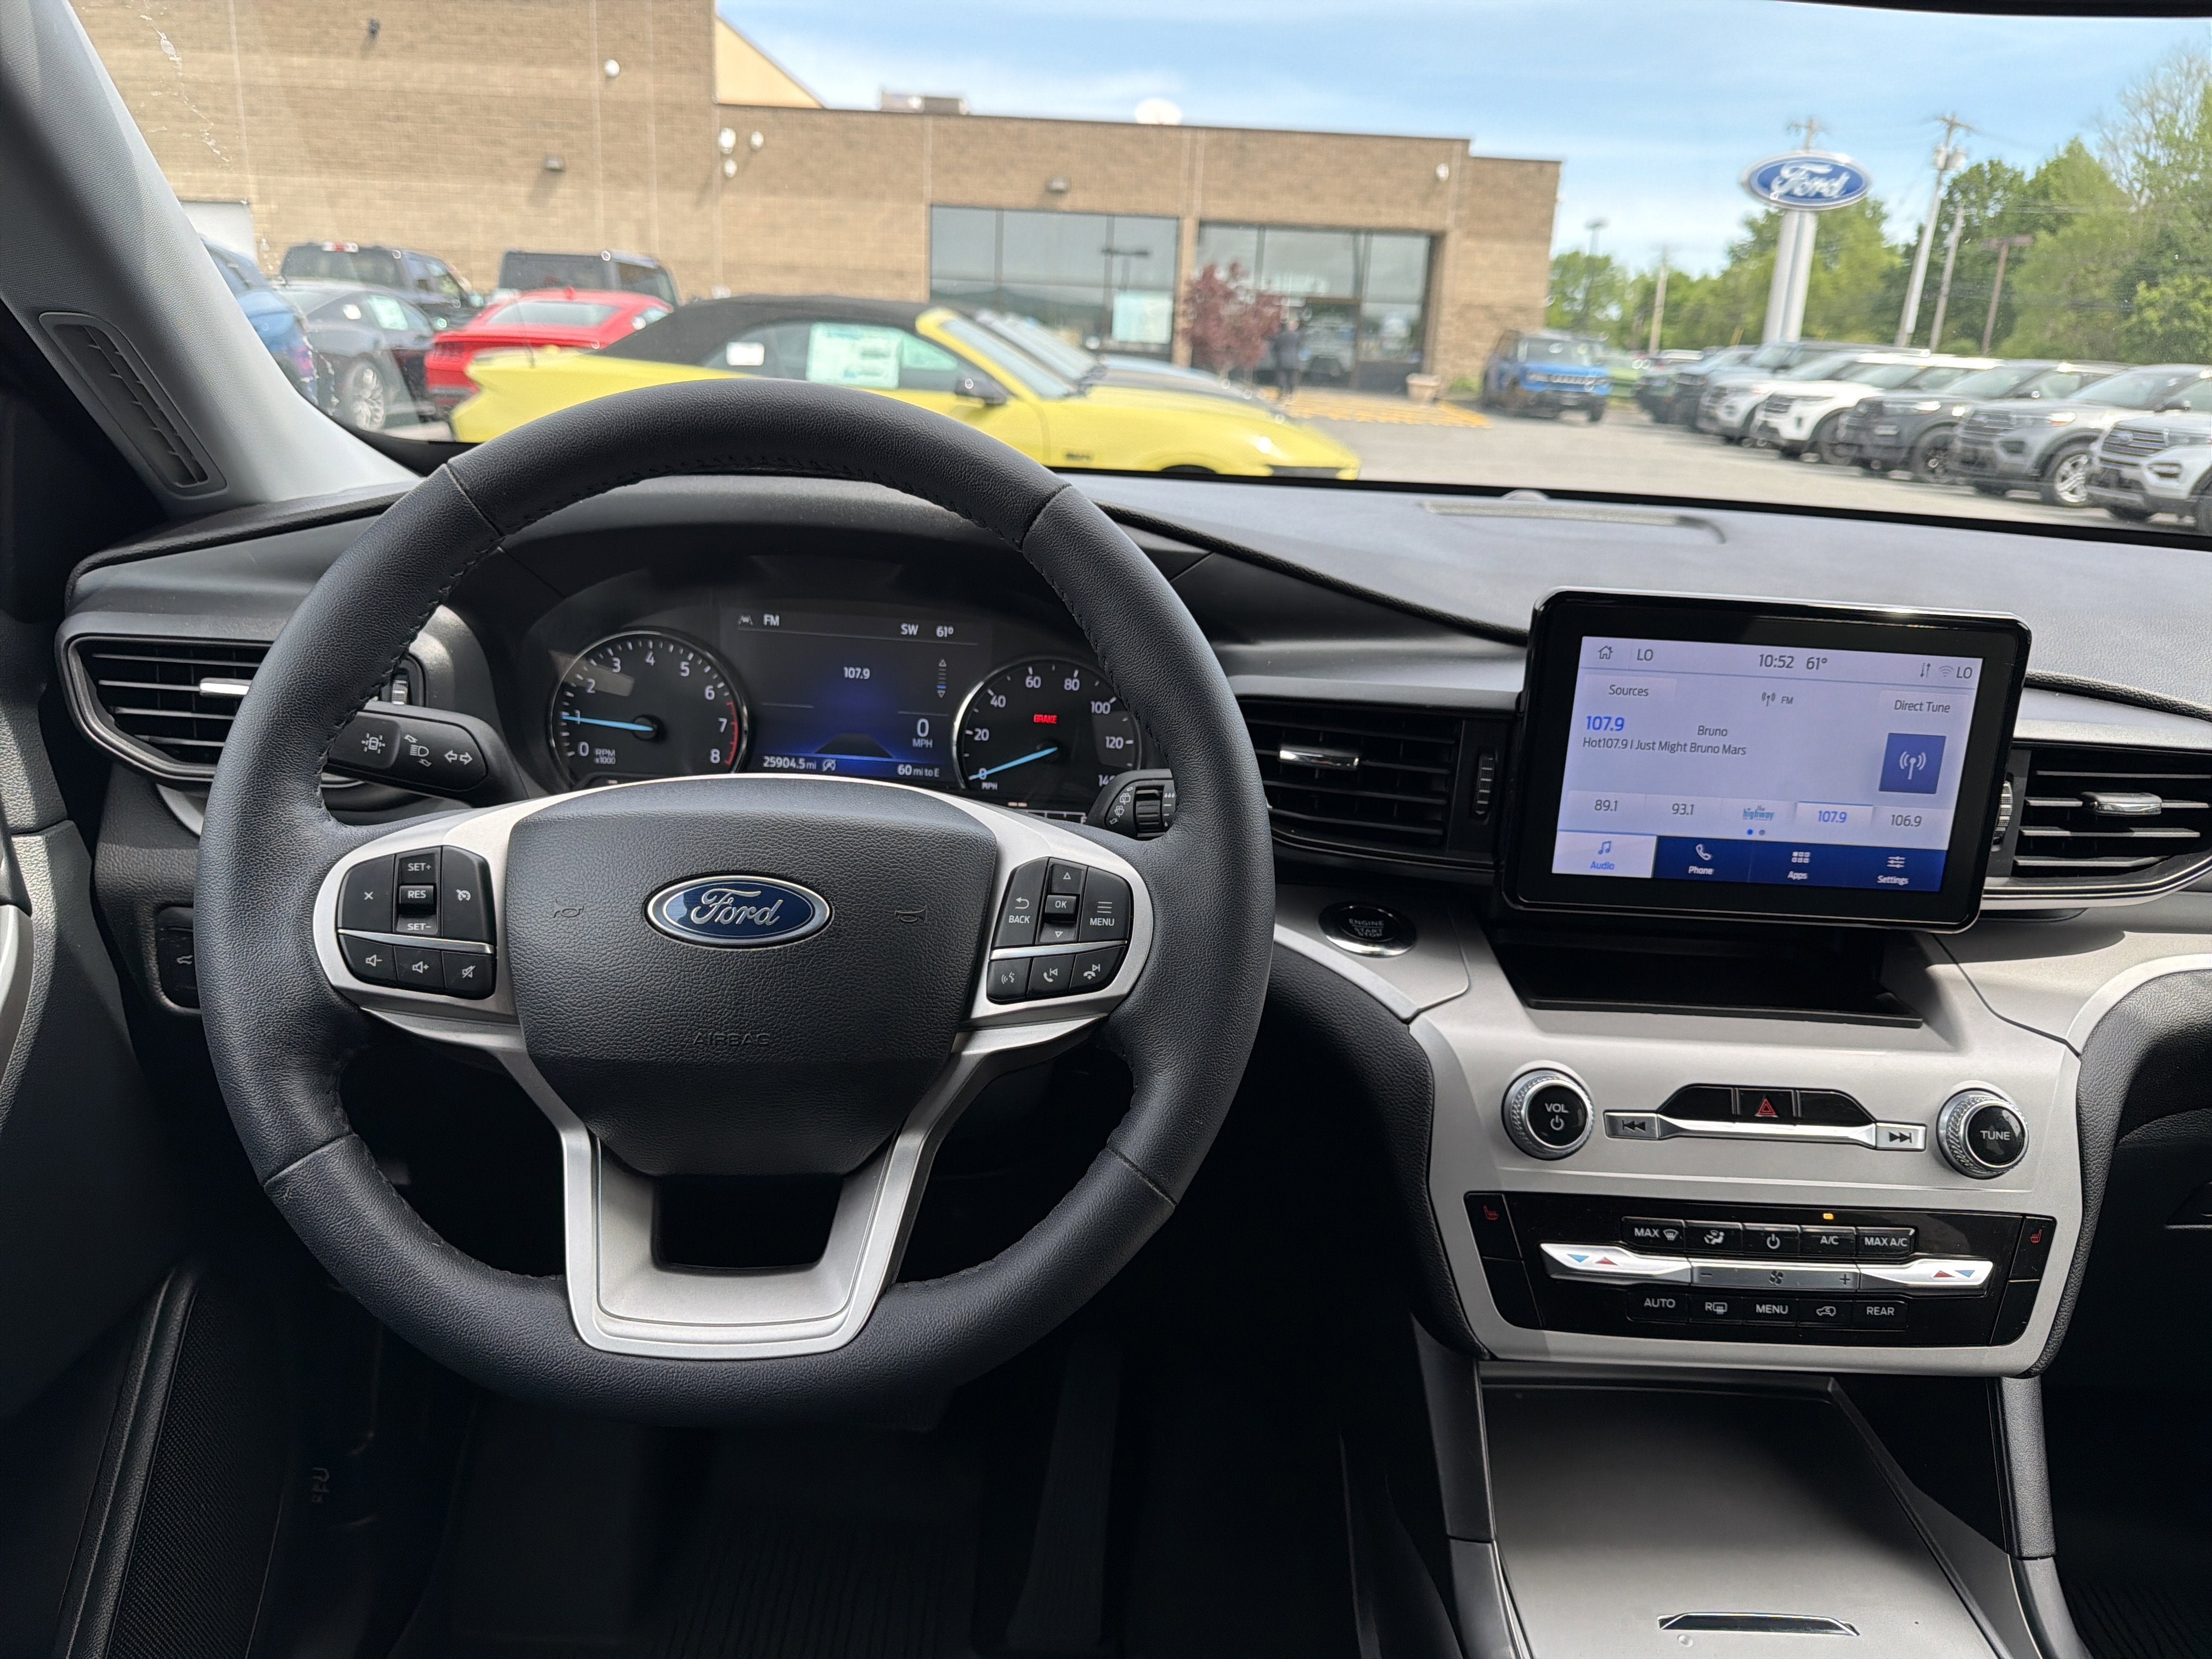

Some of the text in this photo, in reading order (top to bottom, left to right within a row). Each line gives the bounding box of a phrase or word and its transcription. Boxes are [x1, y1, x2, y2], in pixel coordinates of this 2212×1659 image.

[1770, 162, 1850, 198] Ford
[764, 615, 780, 626] FM
[901, 624, 918, 636] SW
[645, 652, 655, 665] 4
[1637, 648, 1653, 662] LO
[612, 657, 621, 673] 3
[1758, 654, 1828, 670] 10:52 61°
[680, 663, 690, 676] 5
[844, 667, 870, 680] 107.9
[1956, 667, 1972, 679] LO
[586, 679, 596, 693] 2
[1025, 676, 1041, 689] 60
[1064, 678, 1080, 691] 80
[704, 686, 715, 700] 6
[1609, 684, 1649, 697] Sources
[990, 695, 1006, 708] 40
[1781, 696, 1793, 705] FM
[1894, 699, 1950, 714] Direct Tune
[1091, 701, 1110, 714] 100
[719, 718, 727, 732] 7
[1033, 714, 1057, 725] BRAKE
[1585, 715, 1624, 732] 107.9
[917, 718, 929, 737] 0
[1697, 725, 1728, 737] Bruno
[974, 729, 989, 741] 20
[912, 738, 932, 748] MPH
[1105, 736, 1124, 749] 120
[1583, 737, 1628, 750] Hot107.9
[1635, 739, 1656, 751] Just
[1658, 740, 1688, 754] Might
[1690, 742, 1719, 754] Bruno
[1722, 744, 1746, 756] Mars
[578, 742, 589, 757] 0
[595, 748, 616, 757] RPM
[710, 749, 720, 764] 8
[763, 755, 816, 770] 25904.5 mi
[898, 764, 912, 776] 60
[924, 768, 933, 777] to
[934, 768, 940, 777] E
[981, 782, 997, 790] MPH
[1098, 774, 1115, 787] 14
[1594, 799, 1618, 812] 89.1
[1671, 803, 1694, 816] 93.1
[1742, 809, 1774, 821] highway
[1818, 810, 1847, 823] 107.9
[1890, 814, 1922, 827] 106.9
[408, 863, 431, 871] SET+
[1590, 860, 1615, 870] Audio
[1688, 866, 1714, 875] Phone
[1787, 870, 1808, 881] Apps
[1877, 874, 1908, 886] Settings
[408, 890, 426, 899] RES
[691, 888, 784, 927] Ford
[1055, 900, 1067, 909] OK
[1008, 915, 1030, 924] BACK
[1090, 918, 1115, 927] MENU
[1348, 918, 1385, 927] ENGINE
[407, 923, 431, 931] SET-
[692, 1032, 770, 1045] AIRBAG
[1545, 1102, 1569, 1114] VOL
[1980, 1130, 2011, 1141] TUNE
[1634, 1227, 1660, 1238] MAX
[1820, 1235, 1839, 1245] A/C
[1865, 1237, 1908, 1248] MAX A/C
[1644, 1297, 1675, 1309] AUTO
[1756, 1304, 1788, 1314] MENU
[1866, 1306, 1895, 1316] REAR
